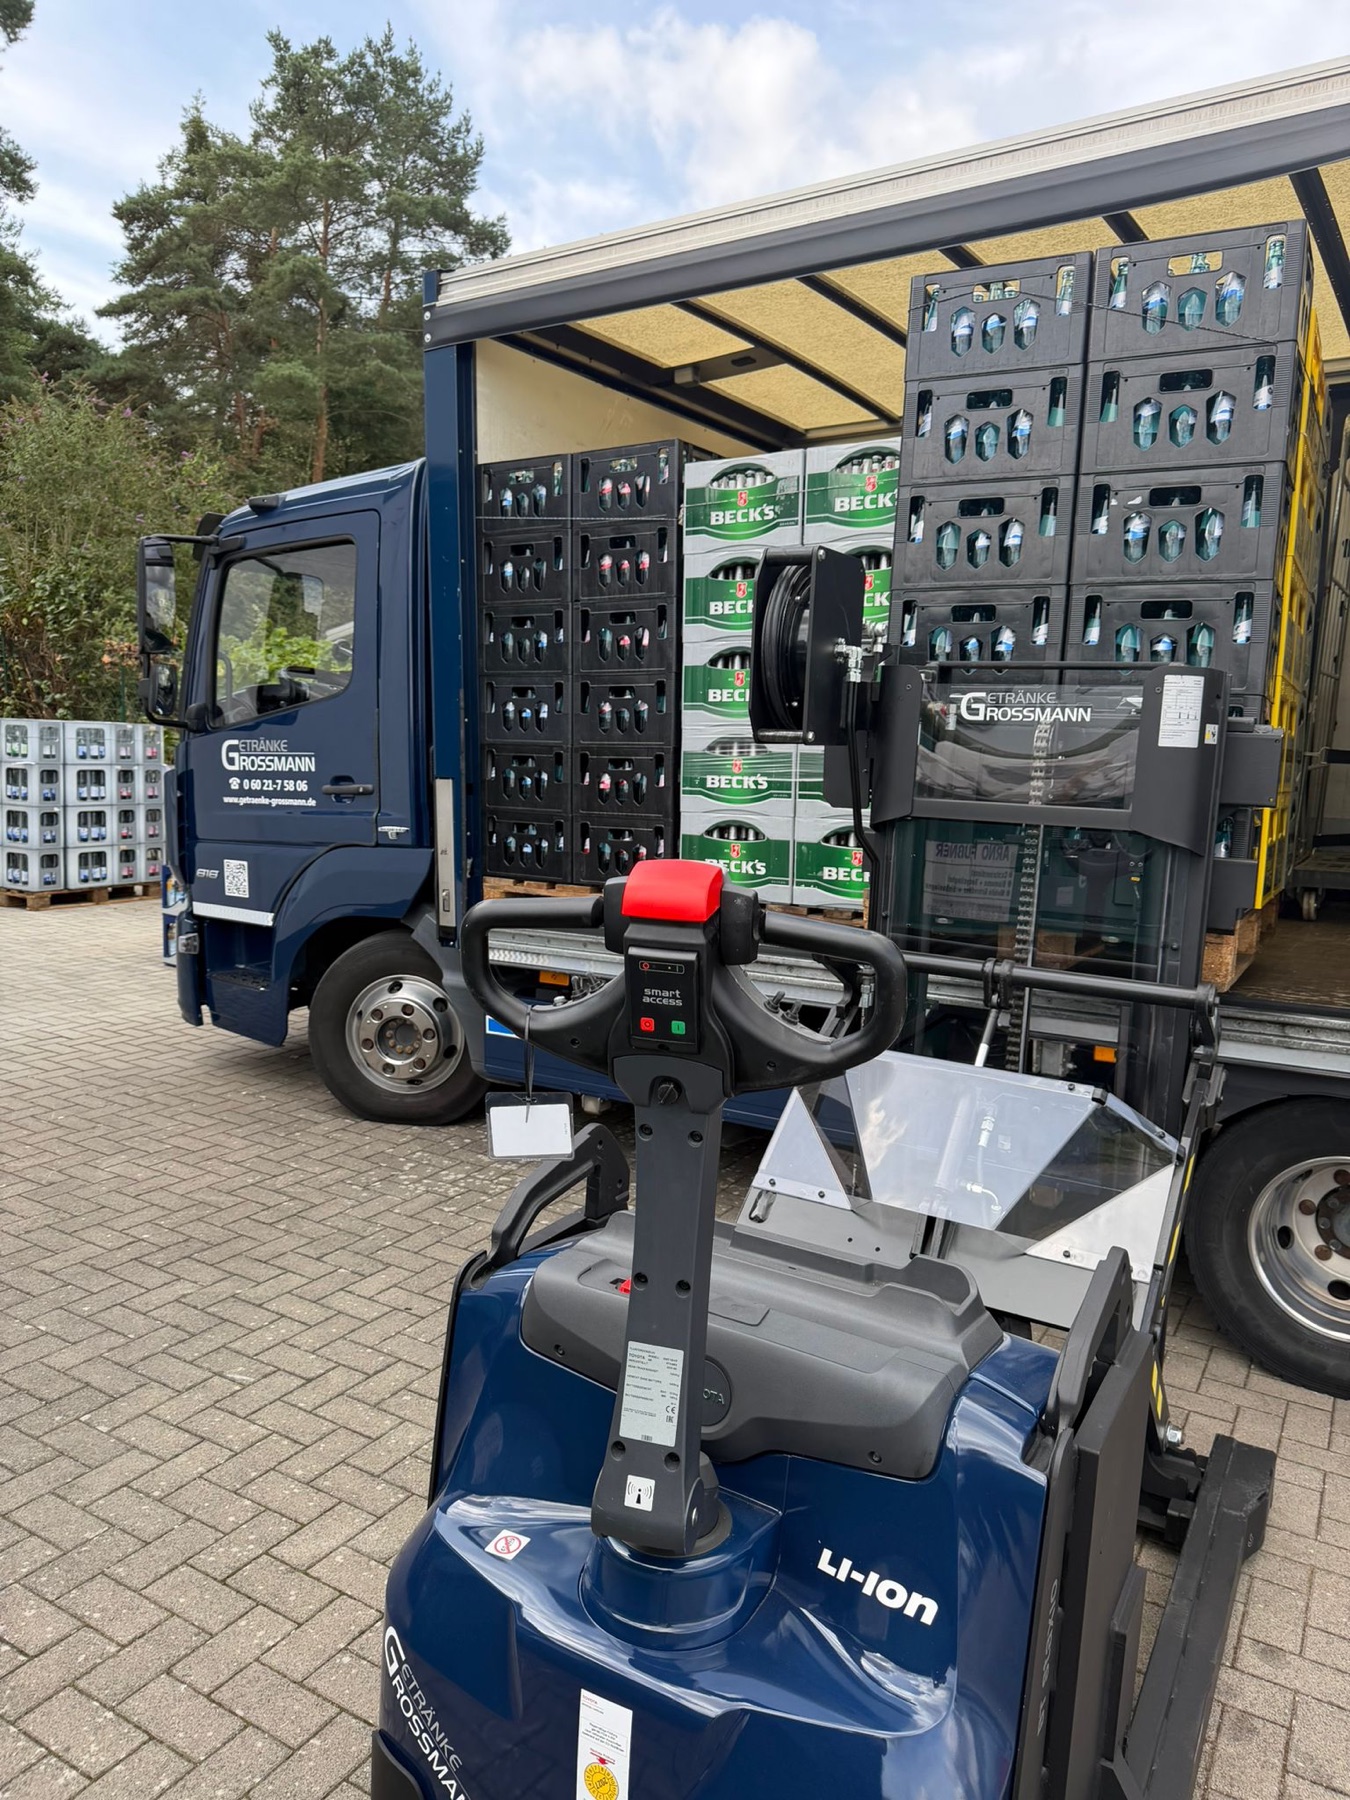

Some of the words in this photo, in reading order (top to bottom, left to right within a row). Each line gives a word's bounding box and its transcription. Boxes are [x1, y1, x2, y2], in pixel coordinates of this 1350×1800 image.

[834, 490, 898, 512] BECK'
[710, 503, 775, 525] BECK'S
[709, 600, 754, 615] BEC
[708, 689, 750, 702] BEC
[960, 691, 1092, 722] GROSSMANN
[221, 739, 316, 772] GROSSMANN
[706, 773, 768, 790] BECK'S
[822, 866, 871, 882] BEC
[642, 996, 683, 1006] access
[644, 988, 681, 998] smart
